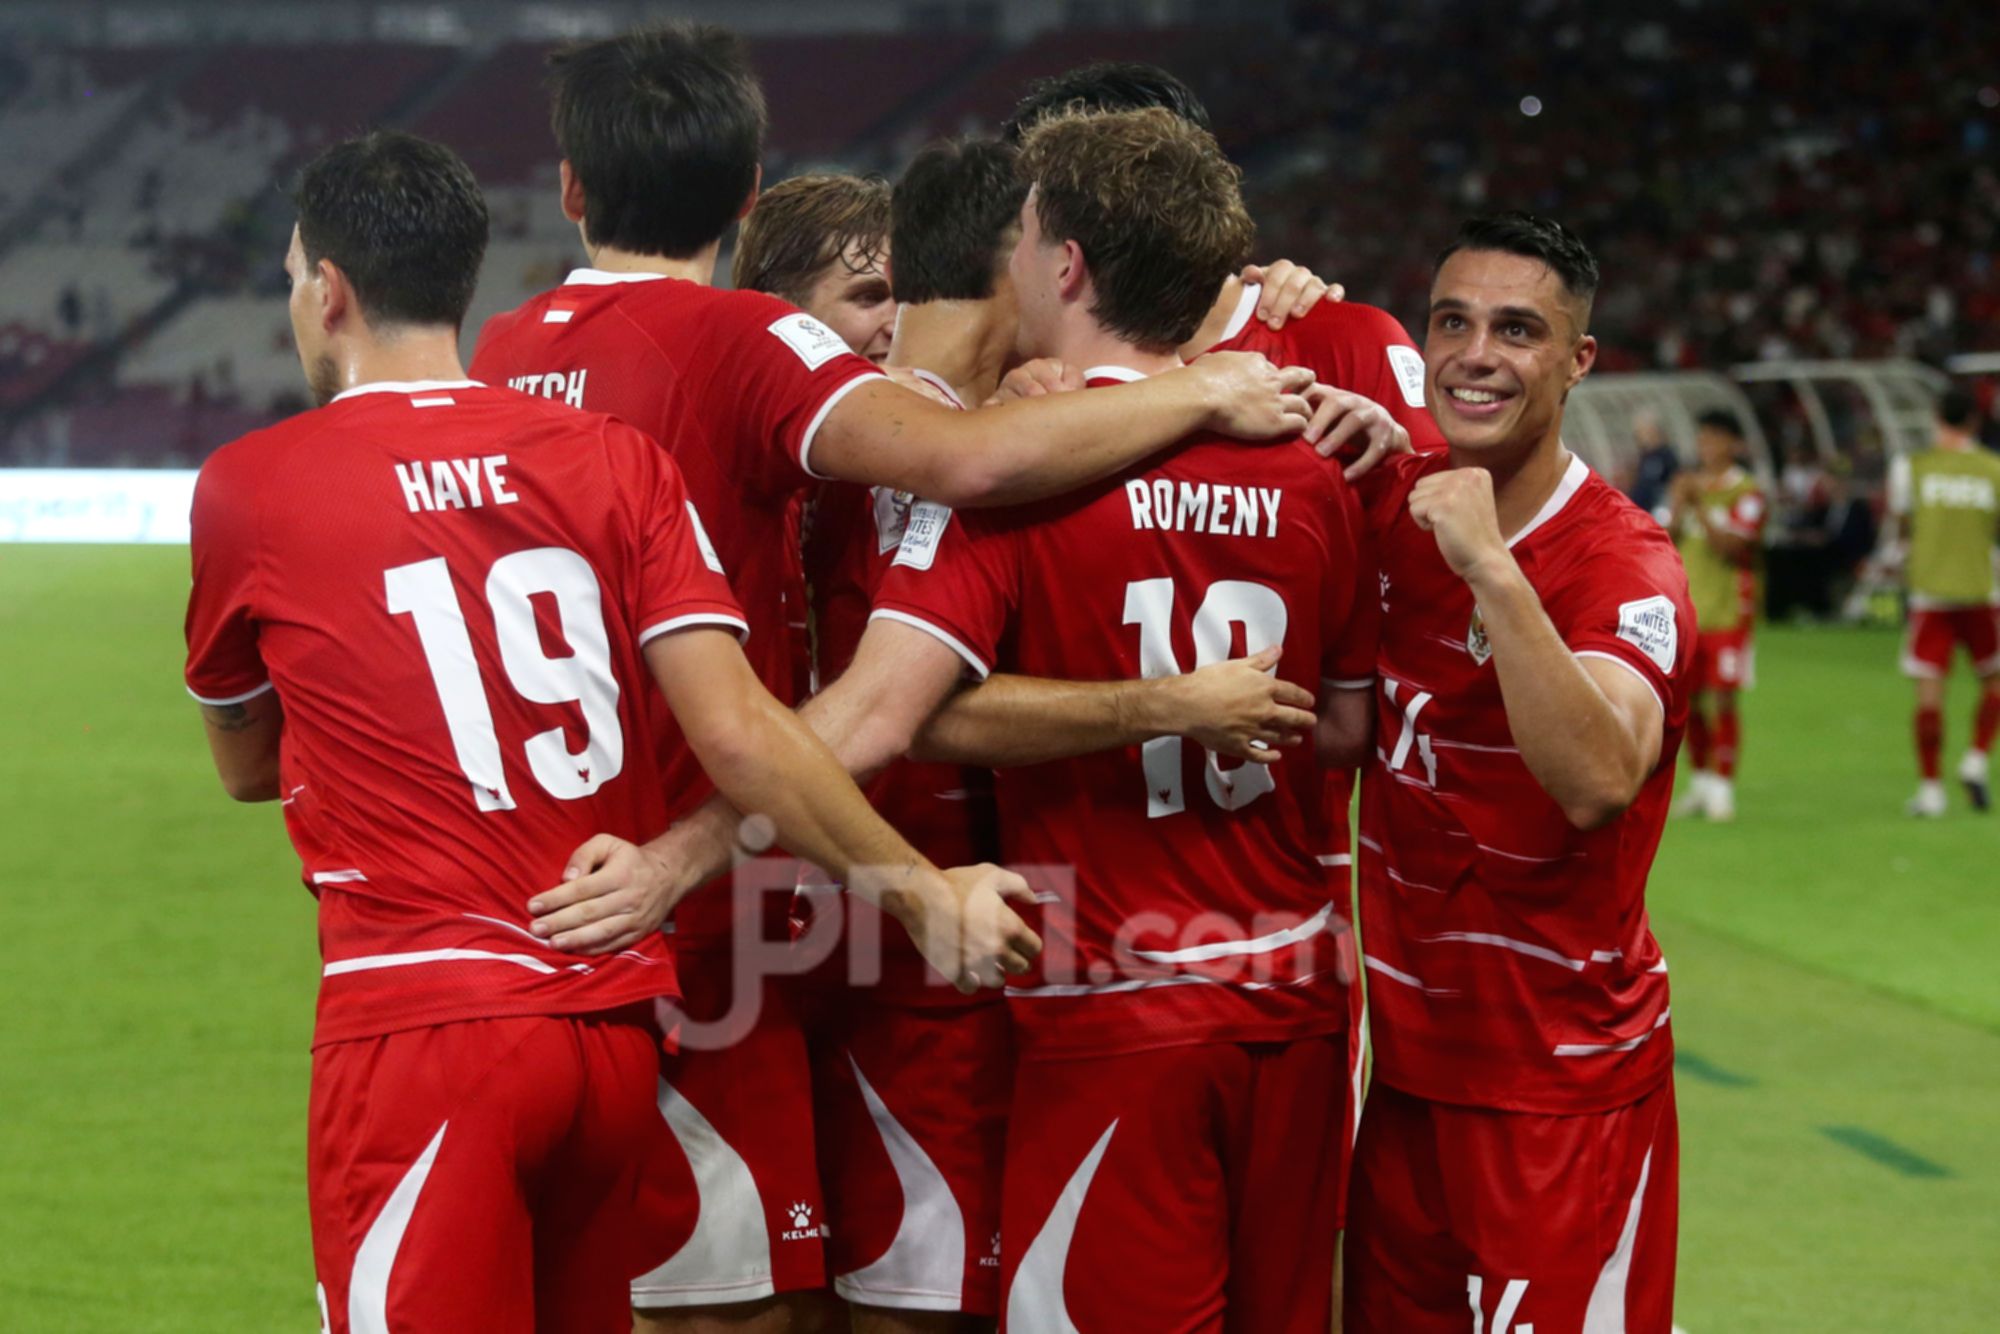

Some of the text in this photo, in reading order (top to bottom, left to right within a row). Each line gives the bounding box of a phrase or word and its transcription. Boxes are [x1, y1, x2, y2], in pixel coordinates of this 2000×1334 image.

[394, 454, 519, 514] HAYE
[1125, 478, 1283, 539] ROMENY
[1633, 611, 1671, 636] UNITES
[383, 547, 625, 813] 19
[979, 1256, 1000, 1266] KEL
